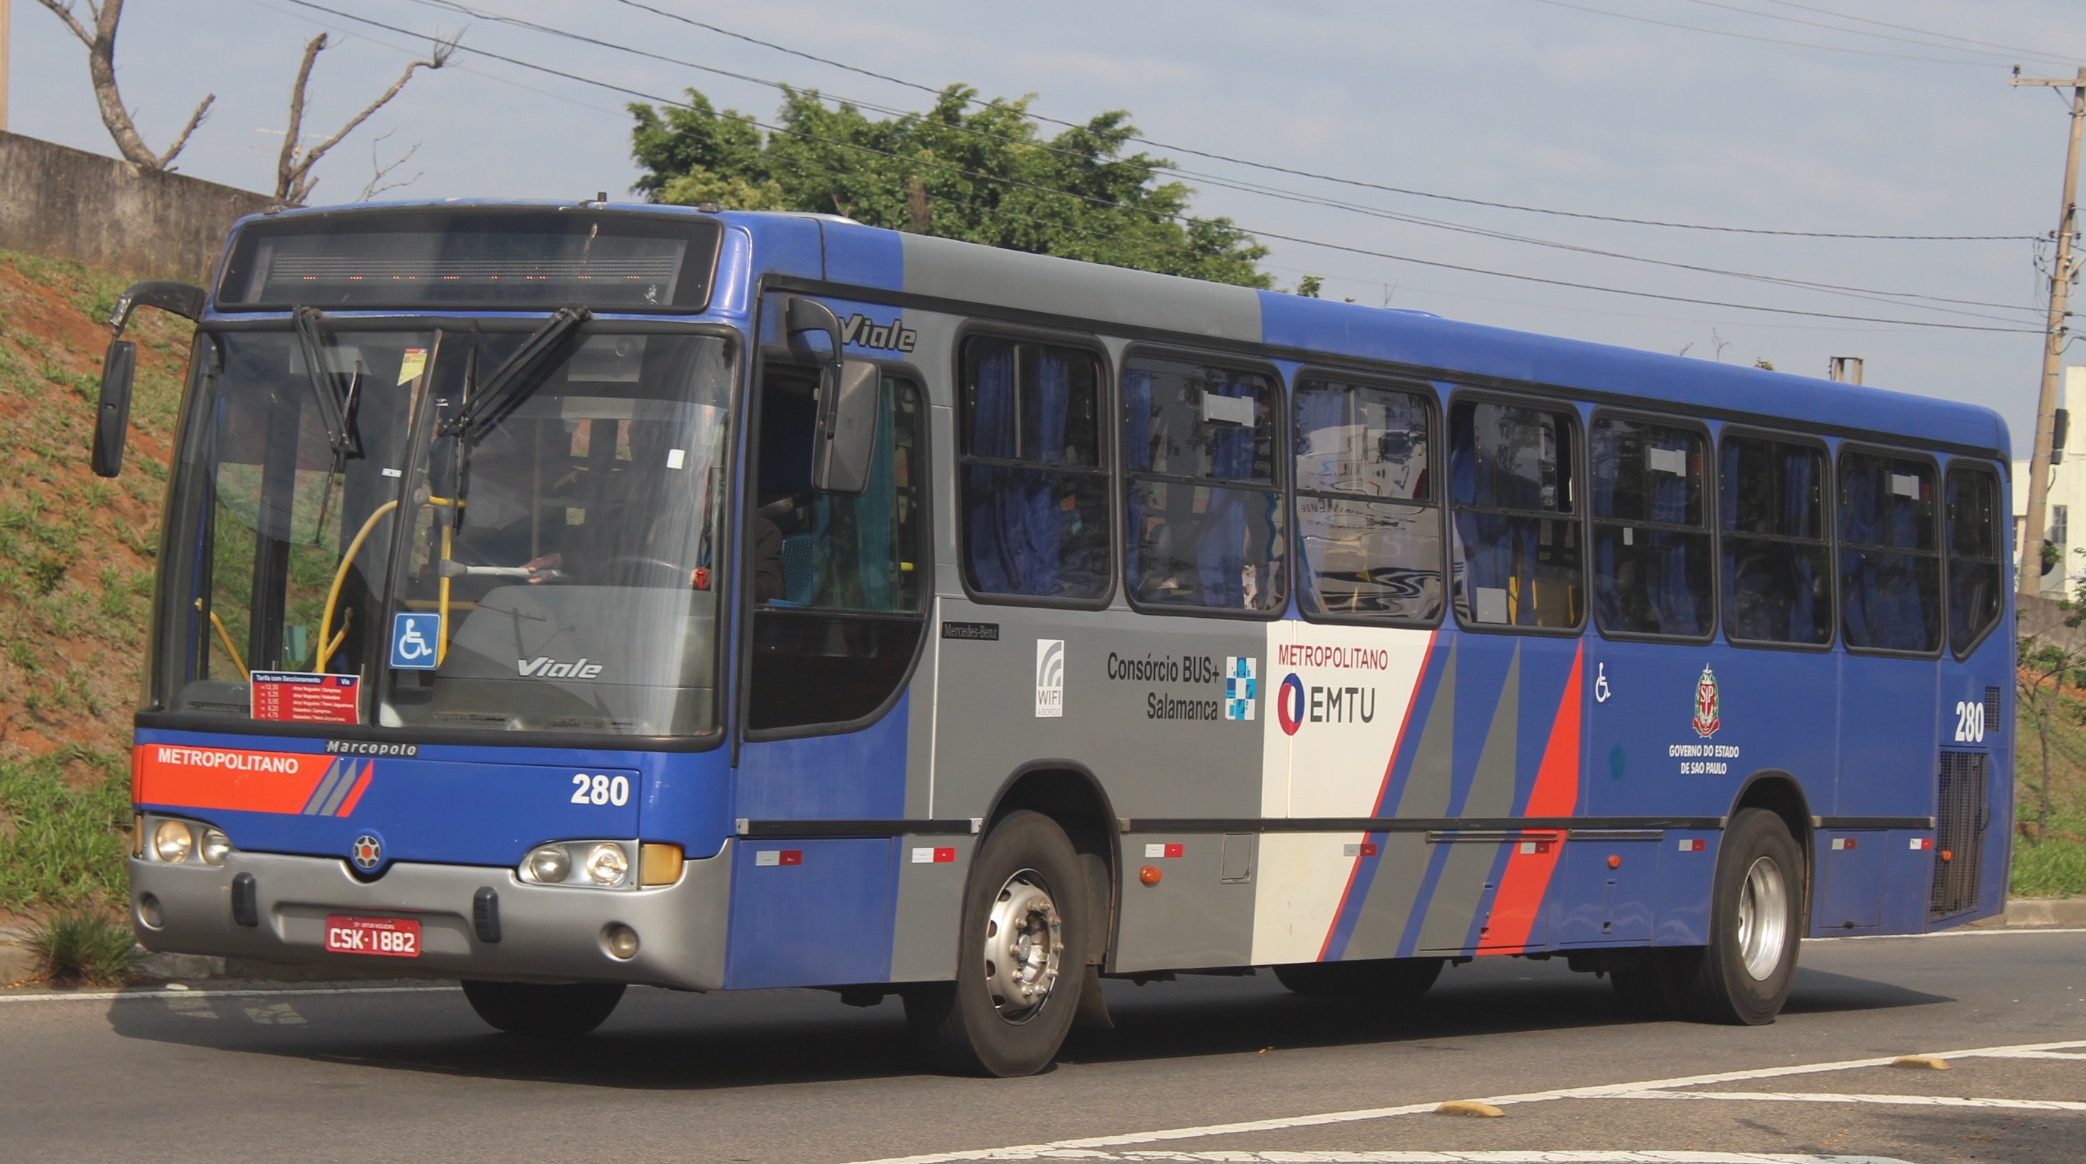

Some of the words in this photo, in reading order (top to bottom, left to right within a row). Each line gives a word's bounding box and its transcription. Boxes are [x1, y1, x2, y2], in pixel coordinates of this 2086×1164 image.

[838, 313, 917, 353] Viale
[943, 623, 998, 639] Mercedes-Benz
[517, 656, 603, 679] Viale
[1107, 652, 1179, 682] Consórcio
[1183, 656, 1220, 684] BUS+
[1278, 644, 1388, 671] METROPOLITANO
[1038, 690, 1061, 705] WIFI
[1147, 692, 1218, 721] Salamanca
[1310, 686, 1375, 723] EMTU
[1955, 701, 1984, 743] 280
[158, 747, 299, 774] METROPOLITANO
[326, 740, 417, 756] Marcopolo
[1668, 744, 1702, 757] GOVERNO
[1703, 744, 1714, 757] DO
[1715, 745, 1740, 758] ESTADO
[1680, 762, 1689, 775] DE
[1706, 762, 1727, 775] PAULO
[570, 773, 629, 807] 280
